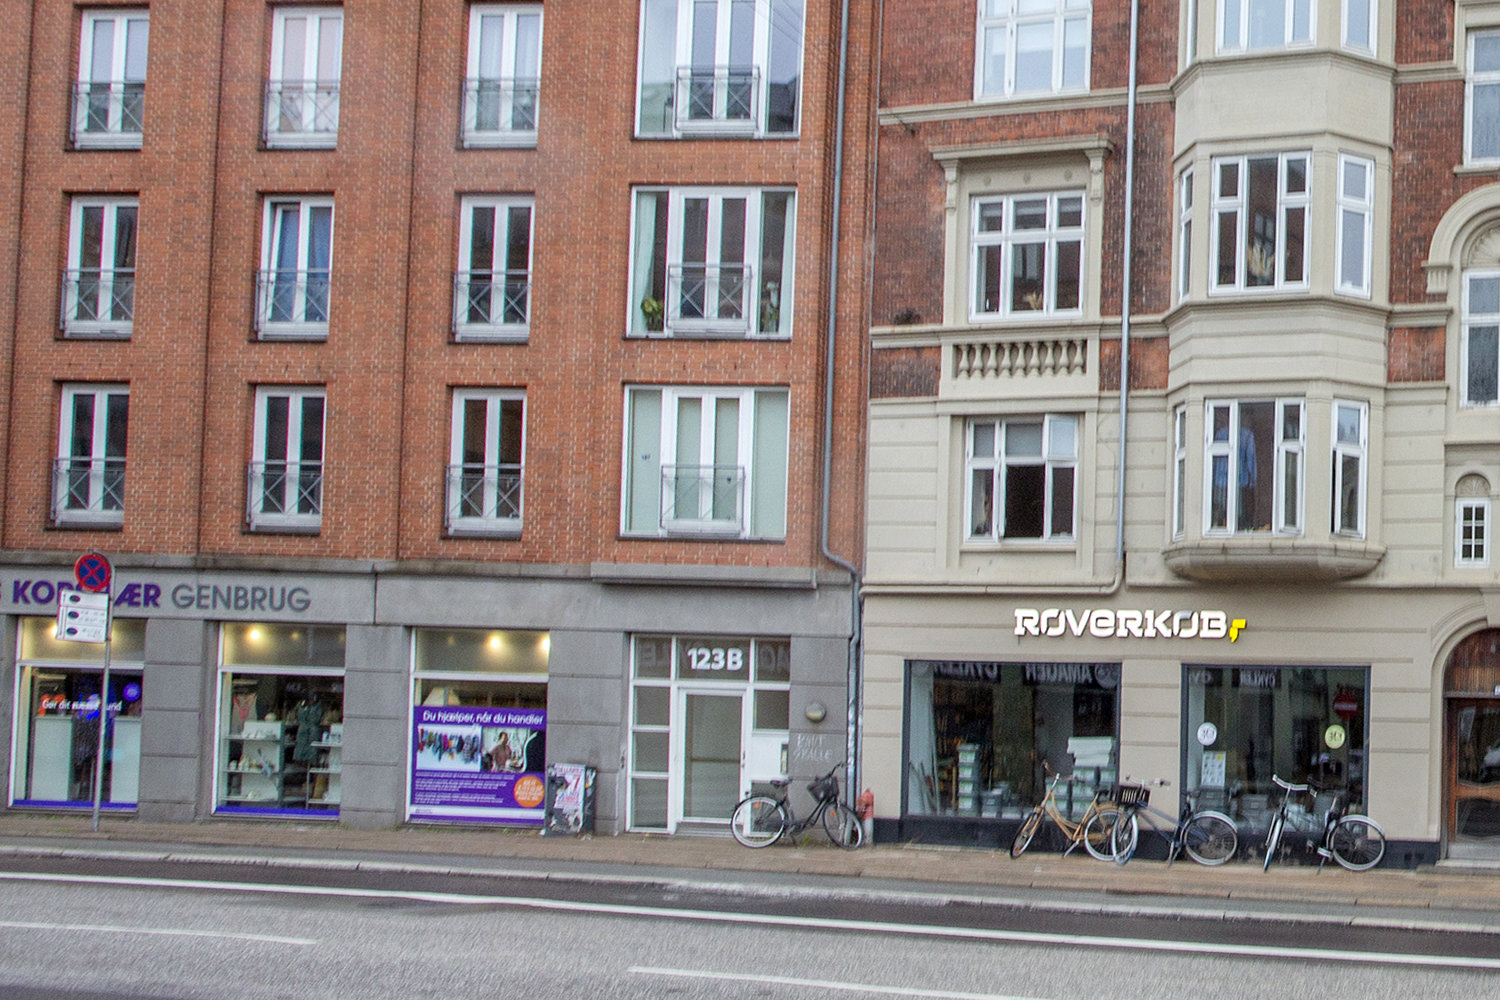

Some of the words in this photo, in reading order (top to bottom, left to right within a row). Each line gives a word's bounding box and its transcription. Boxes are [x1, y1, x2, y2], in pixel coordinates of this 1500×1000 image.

[13, 580, 161, 607] KOÆR
[171, 584, 312, 612] GENBRUG
[687, 648, 743, 671] 123B
[423, 710, 436, 721] Du
[493, 711, 506, 724] du
[507, 712, 544, 725] handler
